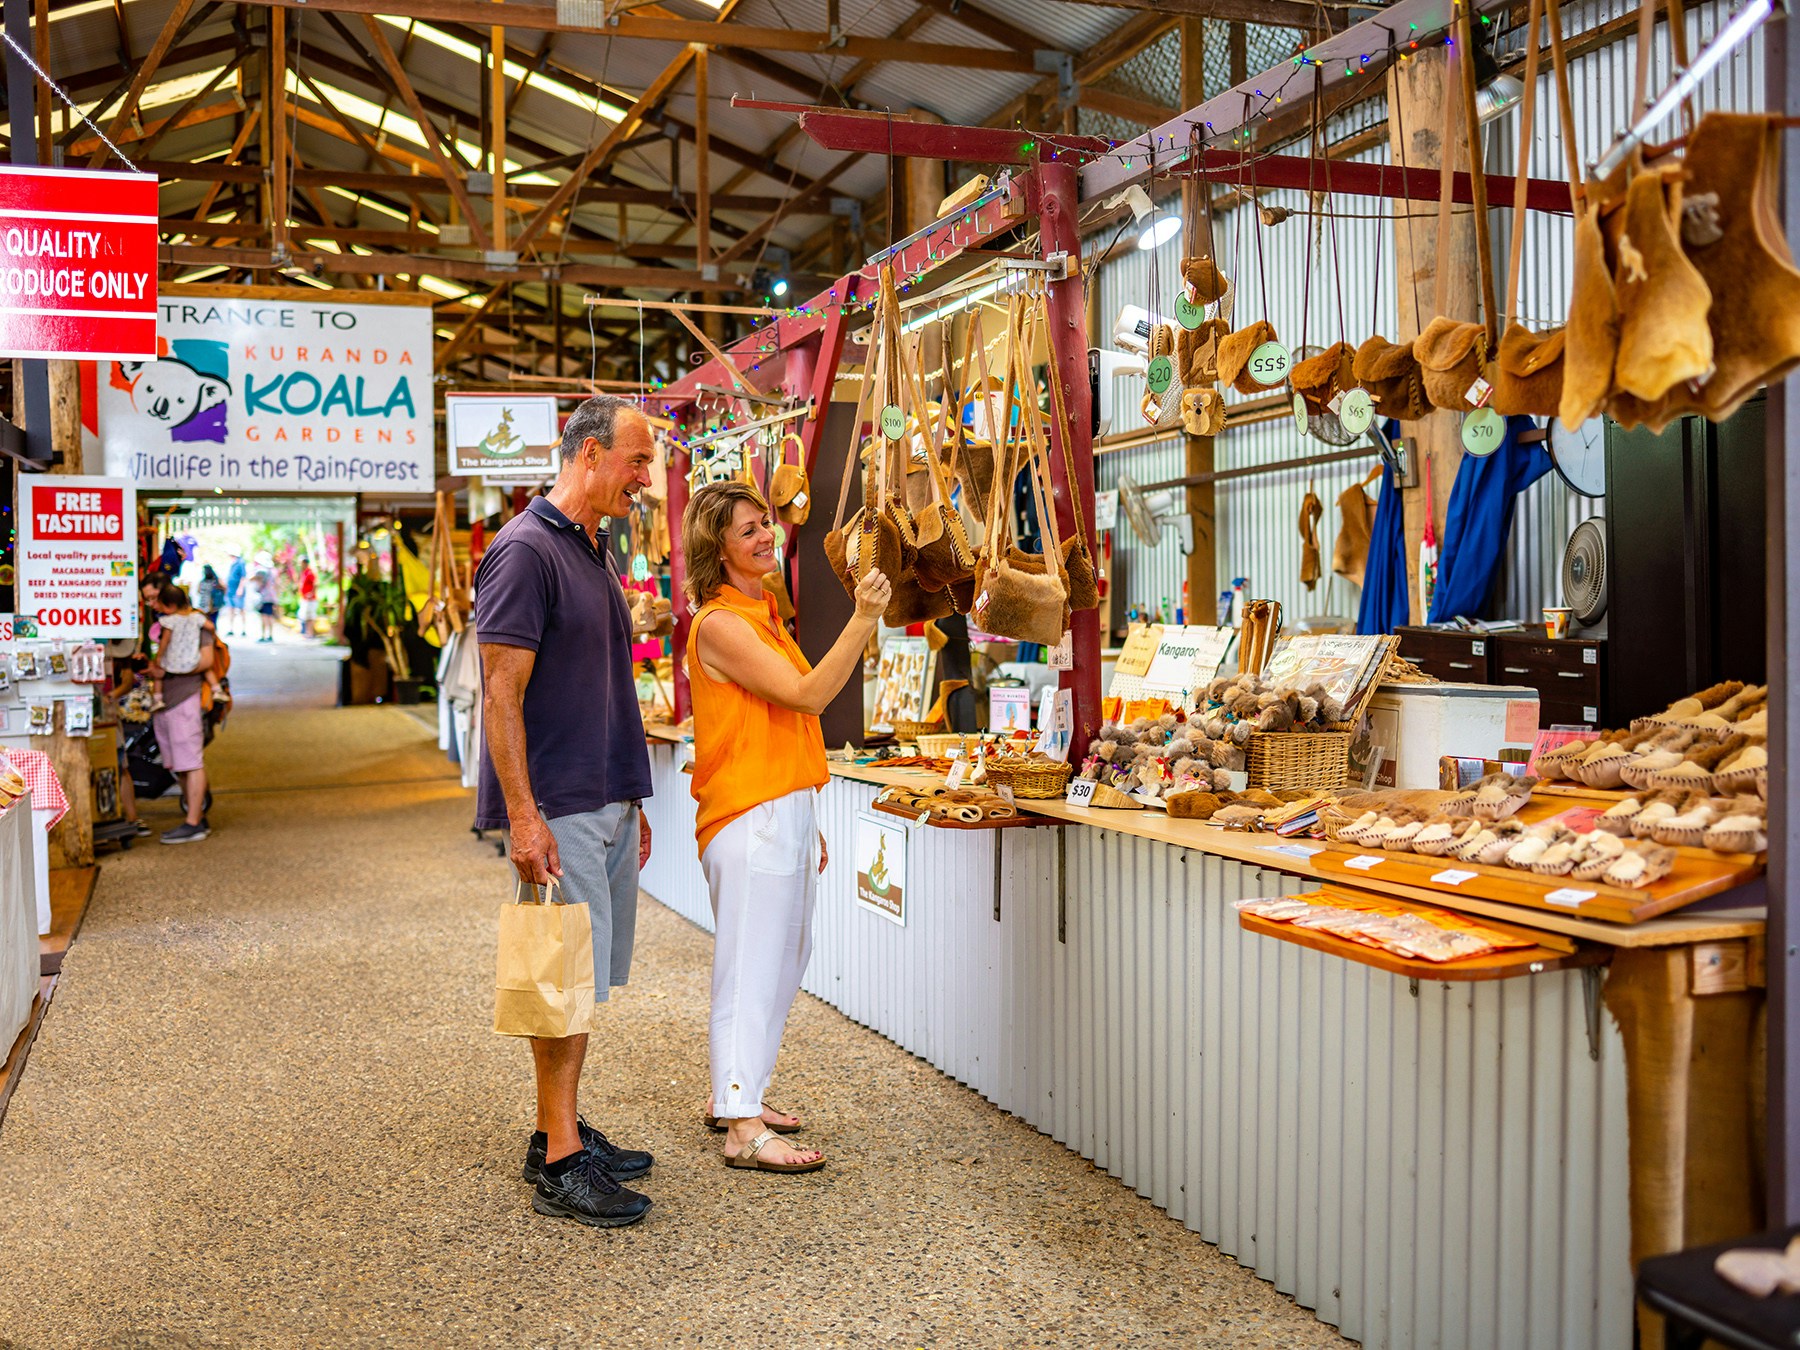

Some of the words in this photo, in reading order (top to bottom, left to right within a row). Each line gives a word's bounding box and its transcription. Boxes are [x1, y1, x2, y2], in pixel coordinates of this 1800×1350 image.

[6, 228, 101, 259] QUALITY
[91, 271, 149, 299] ONLY
[1182, 304, 1197, 317] $30
[312, 310, 357, 330] TO
[245, 345, 413, 366] KURANDA
[1148, 366, 1171, 385] $20
[244, 371, 416, 419] KOALA
[1348, 405, 1364, 418] $65
[885, 418, 901, 428] $100
[1472, 425, 1493, 438] $70
[246, 426, 416, 445] GARDENS
[220, 454, 240, 477] in
[249, 456, 289, 478] the
[294, 455, 419, 481] Rainforest
[461, 458, 479, 467] The
[480, 457, 523, 468] Kangaroo
[525, 456, 549, 467] Shop
[55, 492, 102, 512] FREE
[37, 514, 120, 534] TASTING
[27, 551, 51, 560] Local
[55, 552, 88, 562] quality
[91, 552, 128, 561] produce
[52, 567, 105, 575] MACADAMIAS
[28, 579, 46, 587] BEEF
[34, 591, 58, 599] DRIED
[61, 591, 97, 599] TROPICAL
[100, 591, 122, 599] FRUIT
[37, 608, 122, 626] COOKIES
[1376, 773, 1393, 785] Shop
[1072, 784, 1091, 798] $30
[859, 886, 869, 898] The
[868, 890, 889, 908] Kangaroo
[889, 899, 901, 914] Shop
